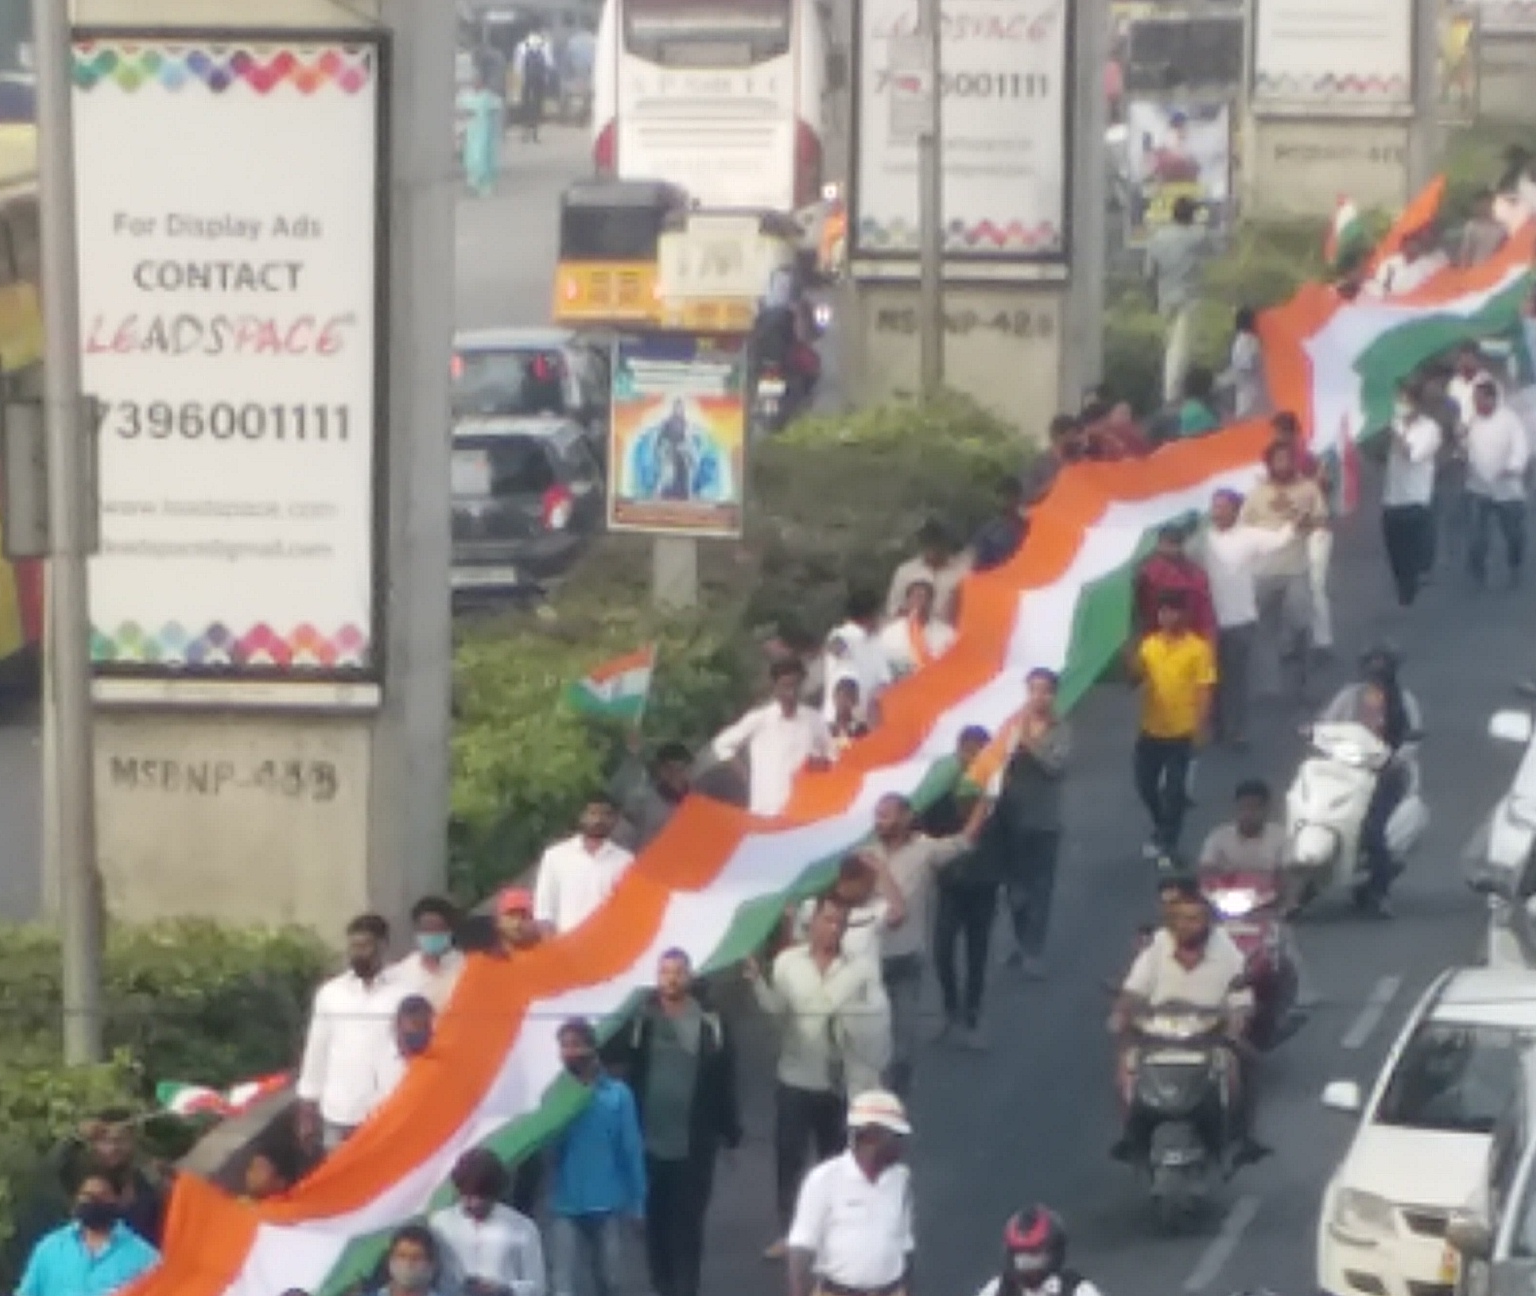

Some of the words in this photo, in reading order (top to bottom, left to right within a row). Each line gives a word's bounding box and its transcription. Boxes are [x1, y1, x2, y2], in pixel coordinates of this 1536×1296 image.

[113, 212, 158, 237] For
[166, 212, 263, 241] Display
[272, 212, 322, 238] Ads
[132, 260, 305, 292] CONTACT
[85, 312, 350, 357] LEADSPACE
